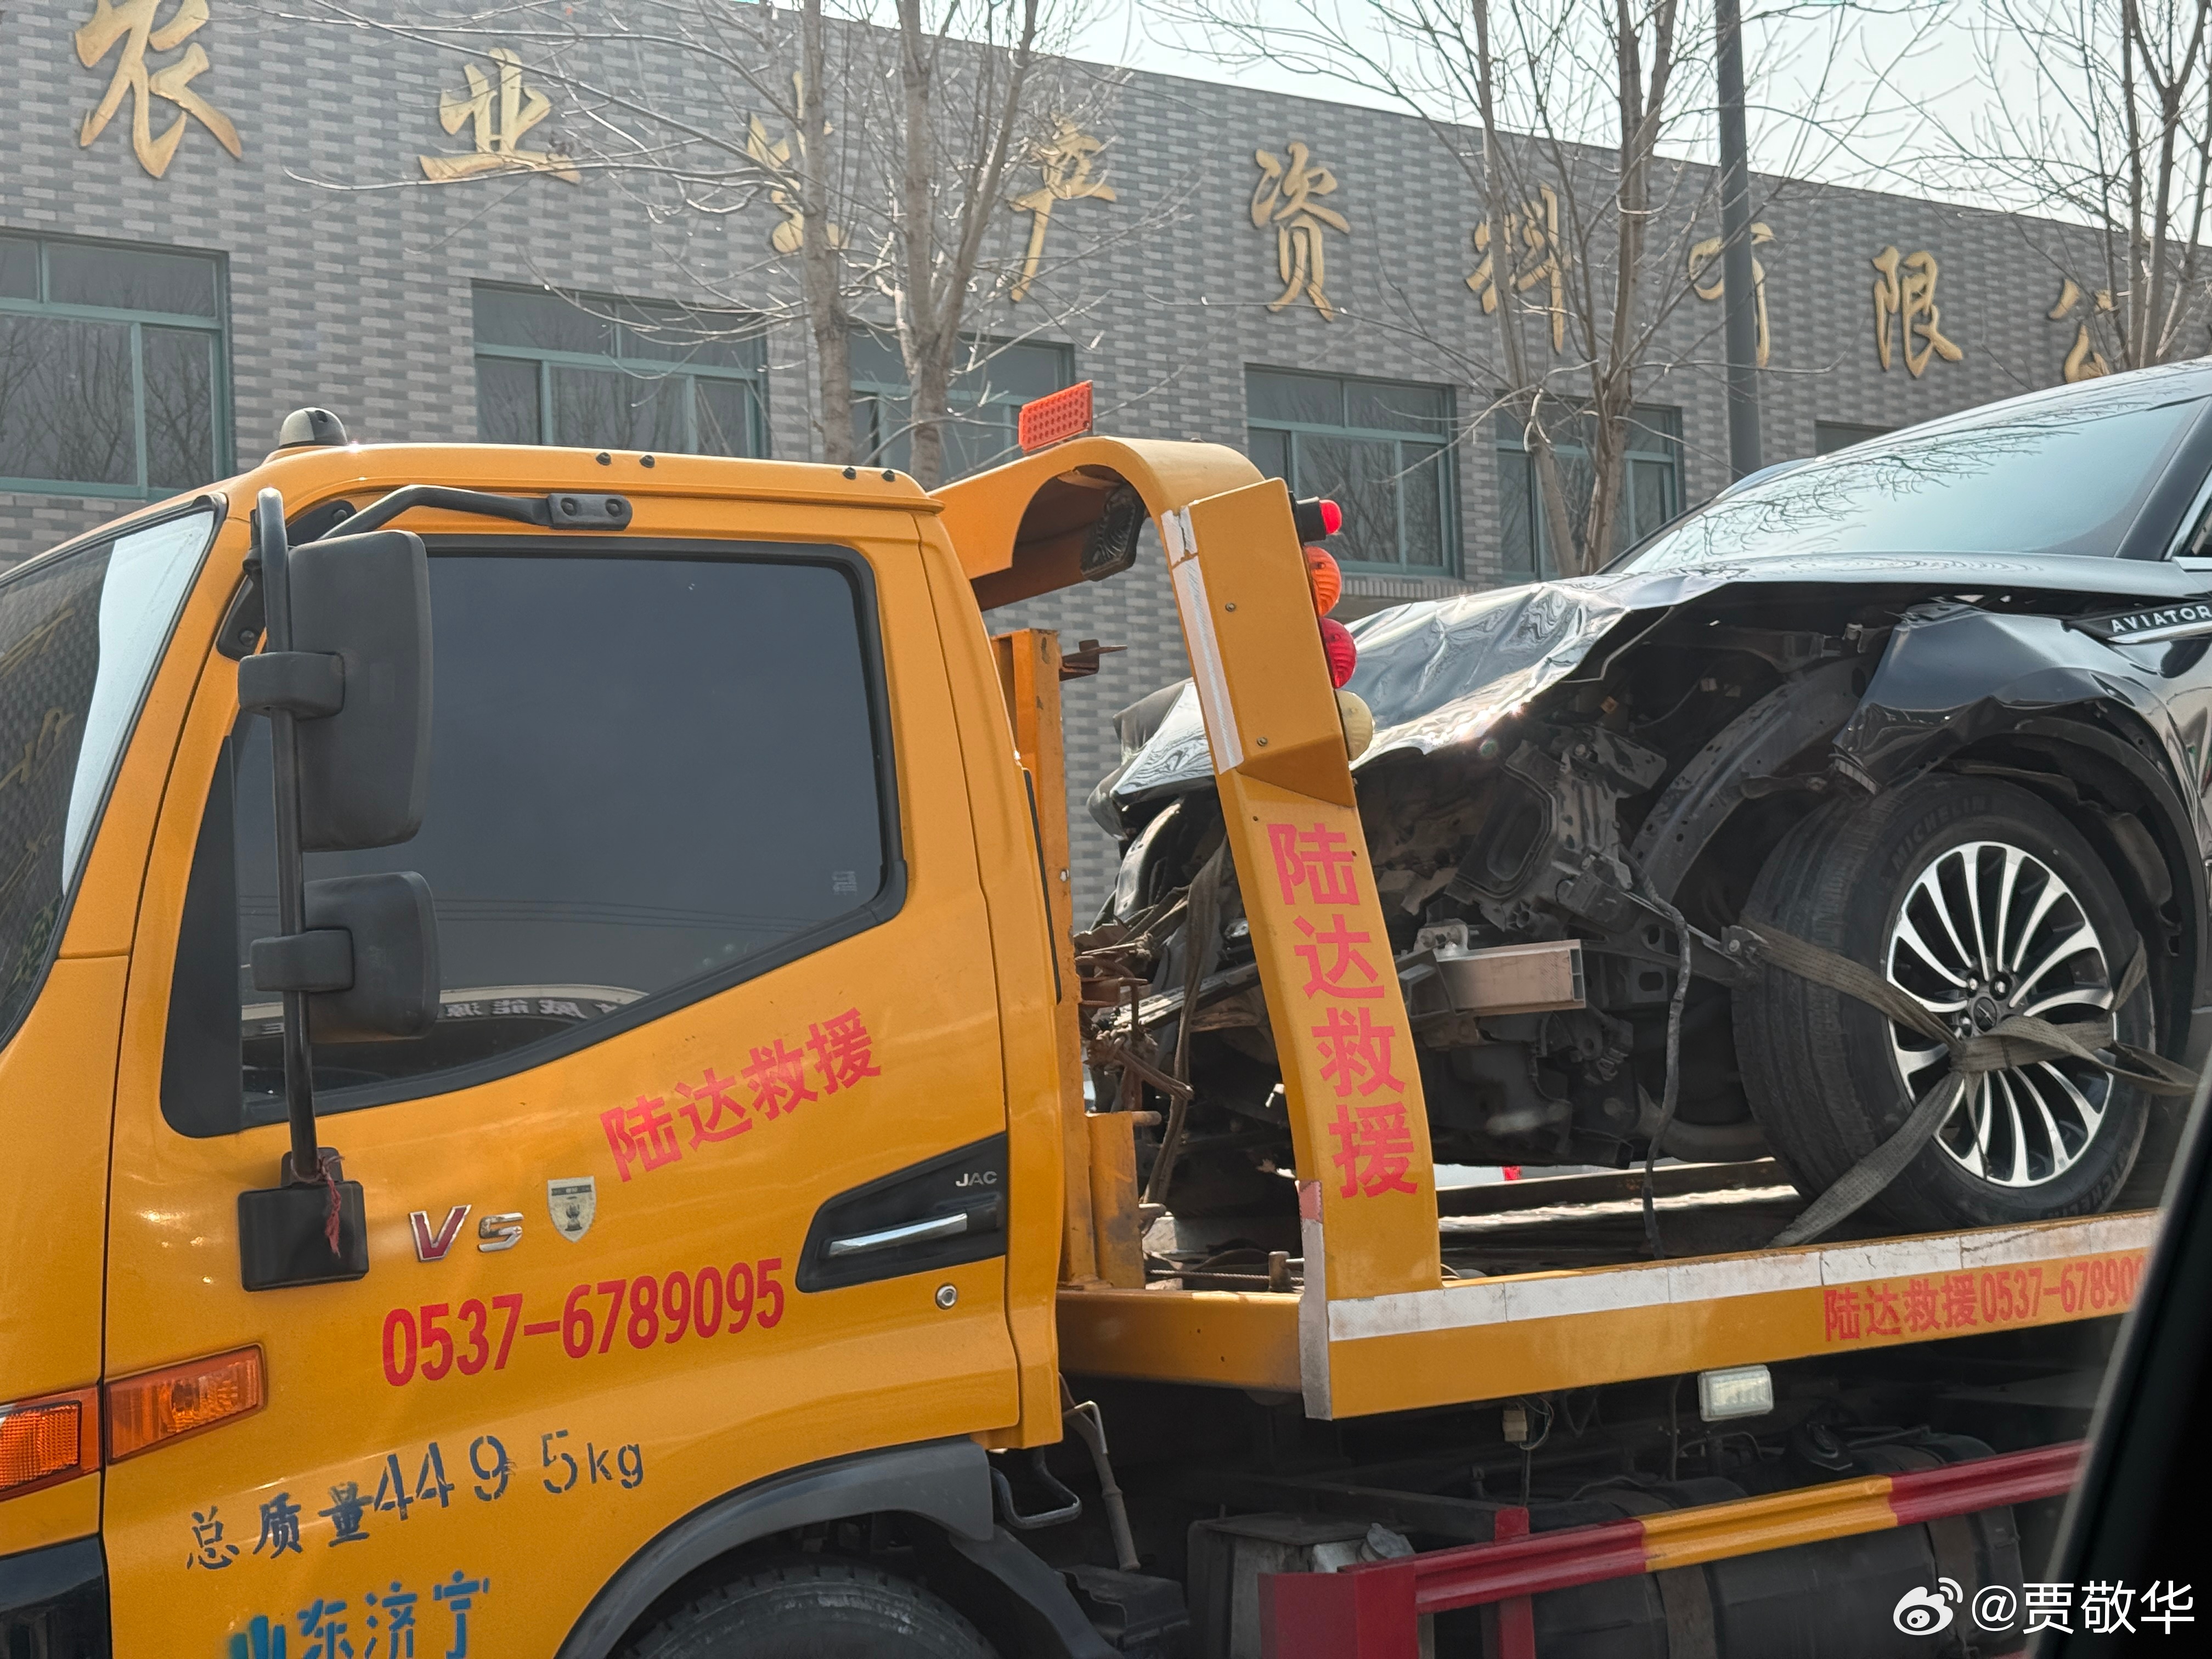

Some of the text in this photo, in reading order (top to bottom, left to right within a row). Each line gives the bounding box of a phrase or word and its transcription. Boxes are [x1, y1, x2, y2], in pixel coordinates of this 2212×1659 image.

[2111, 605, 2212, 633] AVIATOR
[1266, 822, 1418, 1199] 陆达救援
[600, 1006, 881, 1182] 陆达救援
[955, 1170, 997, 1187] JAC
[381, 1257, 785, 1387] 0537-6789095
[1822, 1255, 2144, 1342] 陆达救援0537-67890
